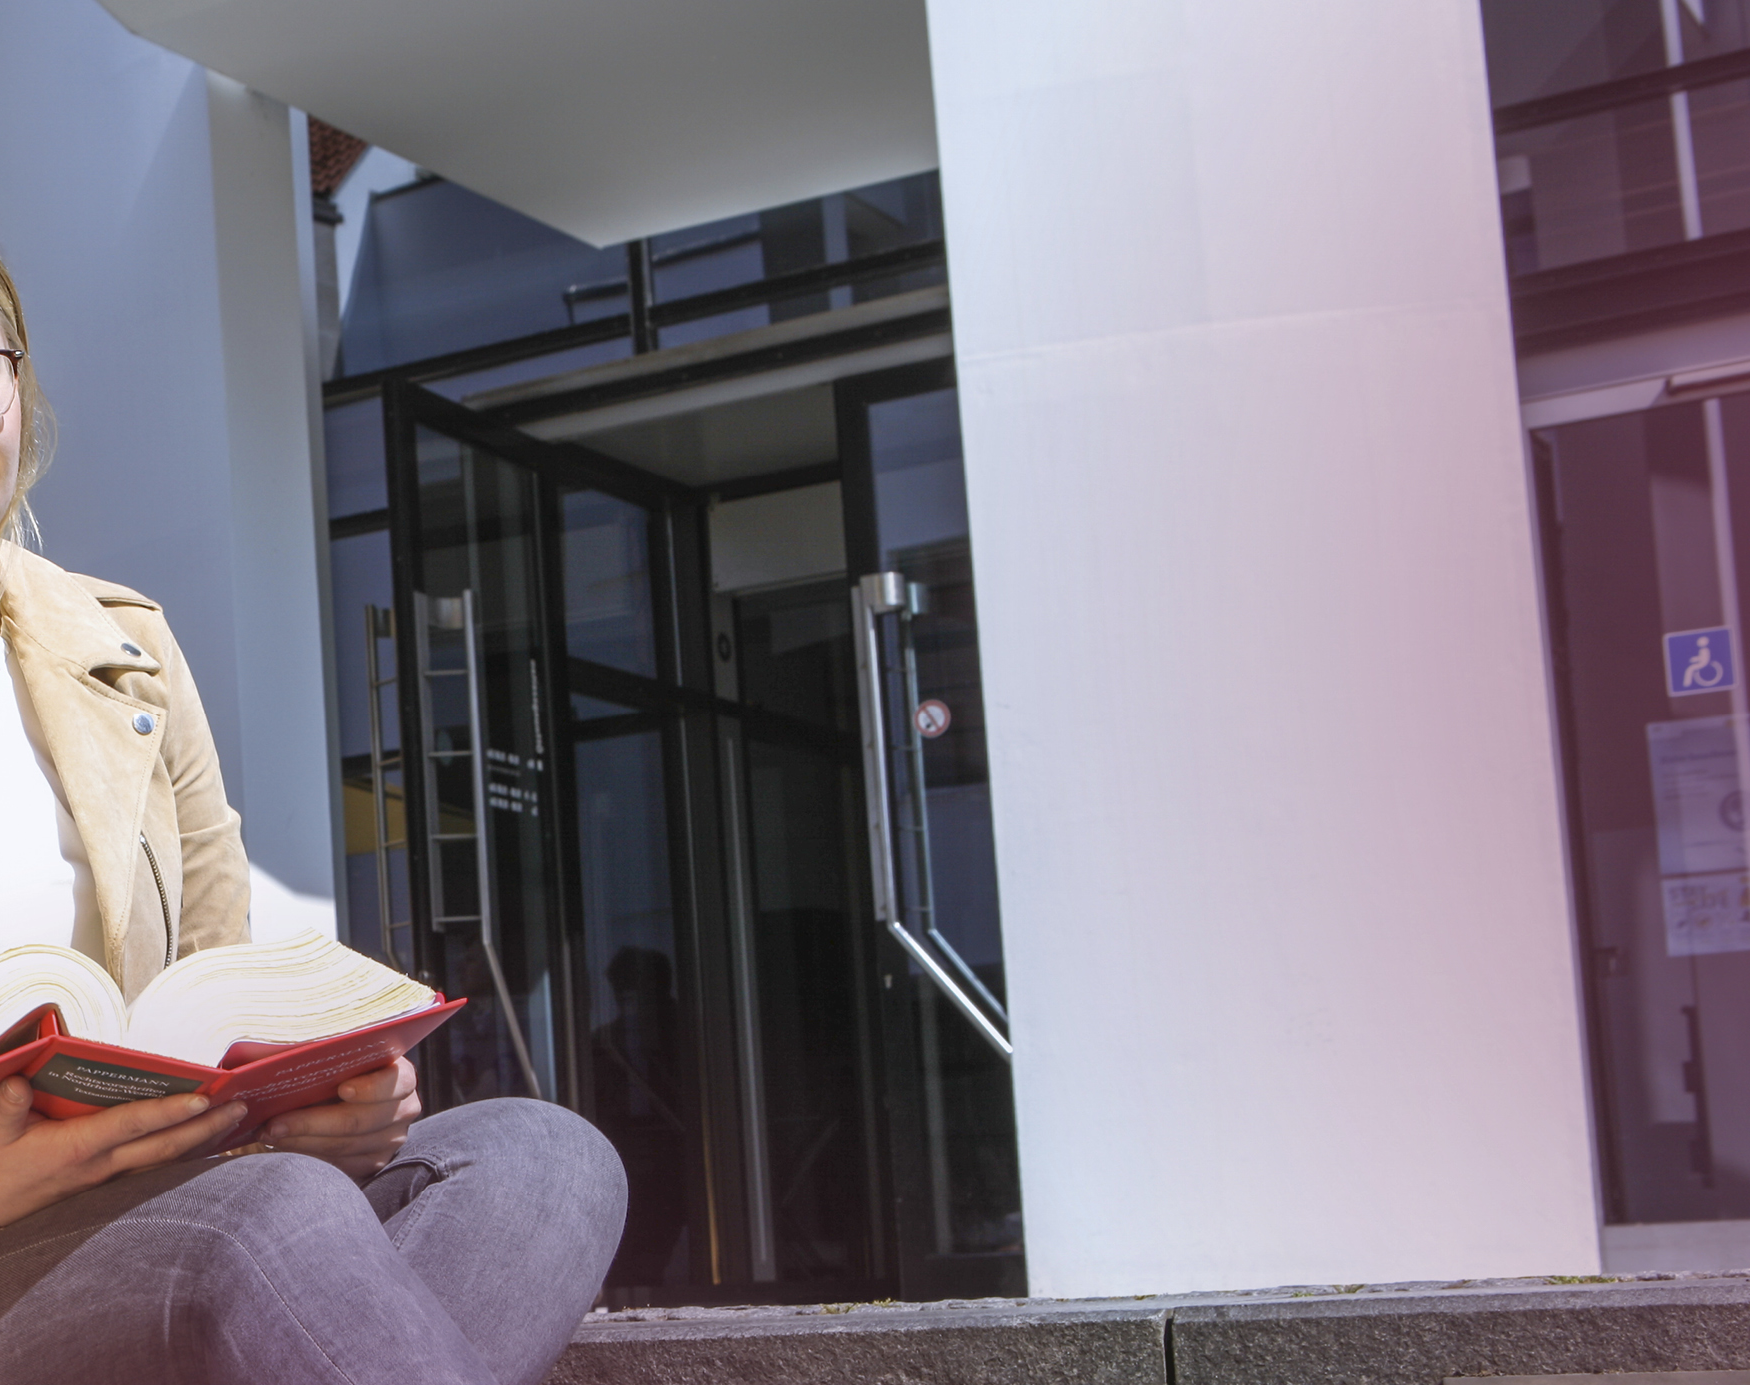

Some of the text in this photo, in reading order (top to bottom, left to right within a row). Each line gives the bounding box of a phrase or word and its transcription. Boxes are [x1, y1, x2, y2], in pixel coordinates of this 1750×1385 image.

[48, 1070, 167, 1099] in Nordrhein-Westfale
[64, 1070, 166, 1095] Rechtsvorschriften
[76, 1065, 170, 1087] PAPPERMANN
